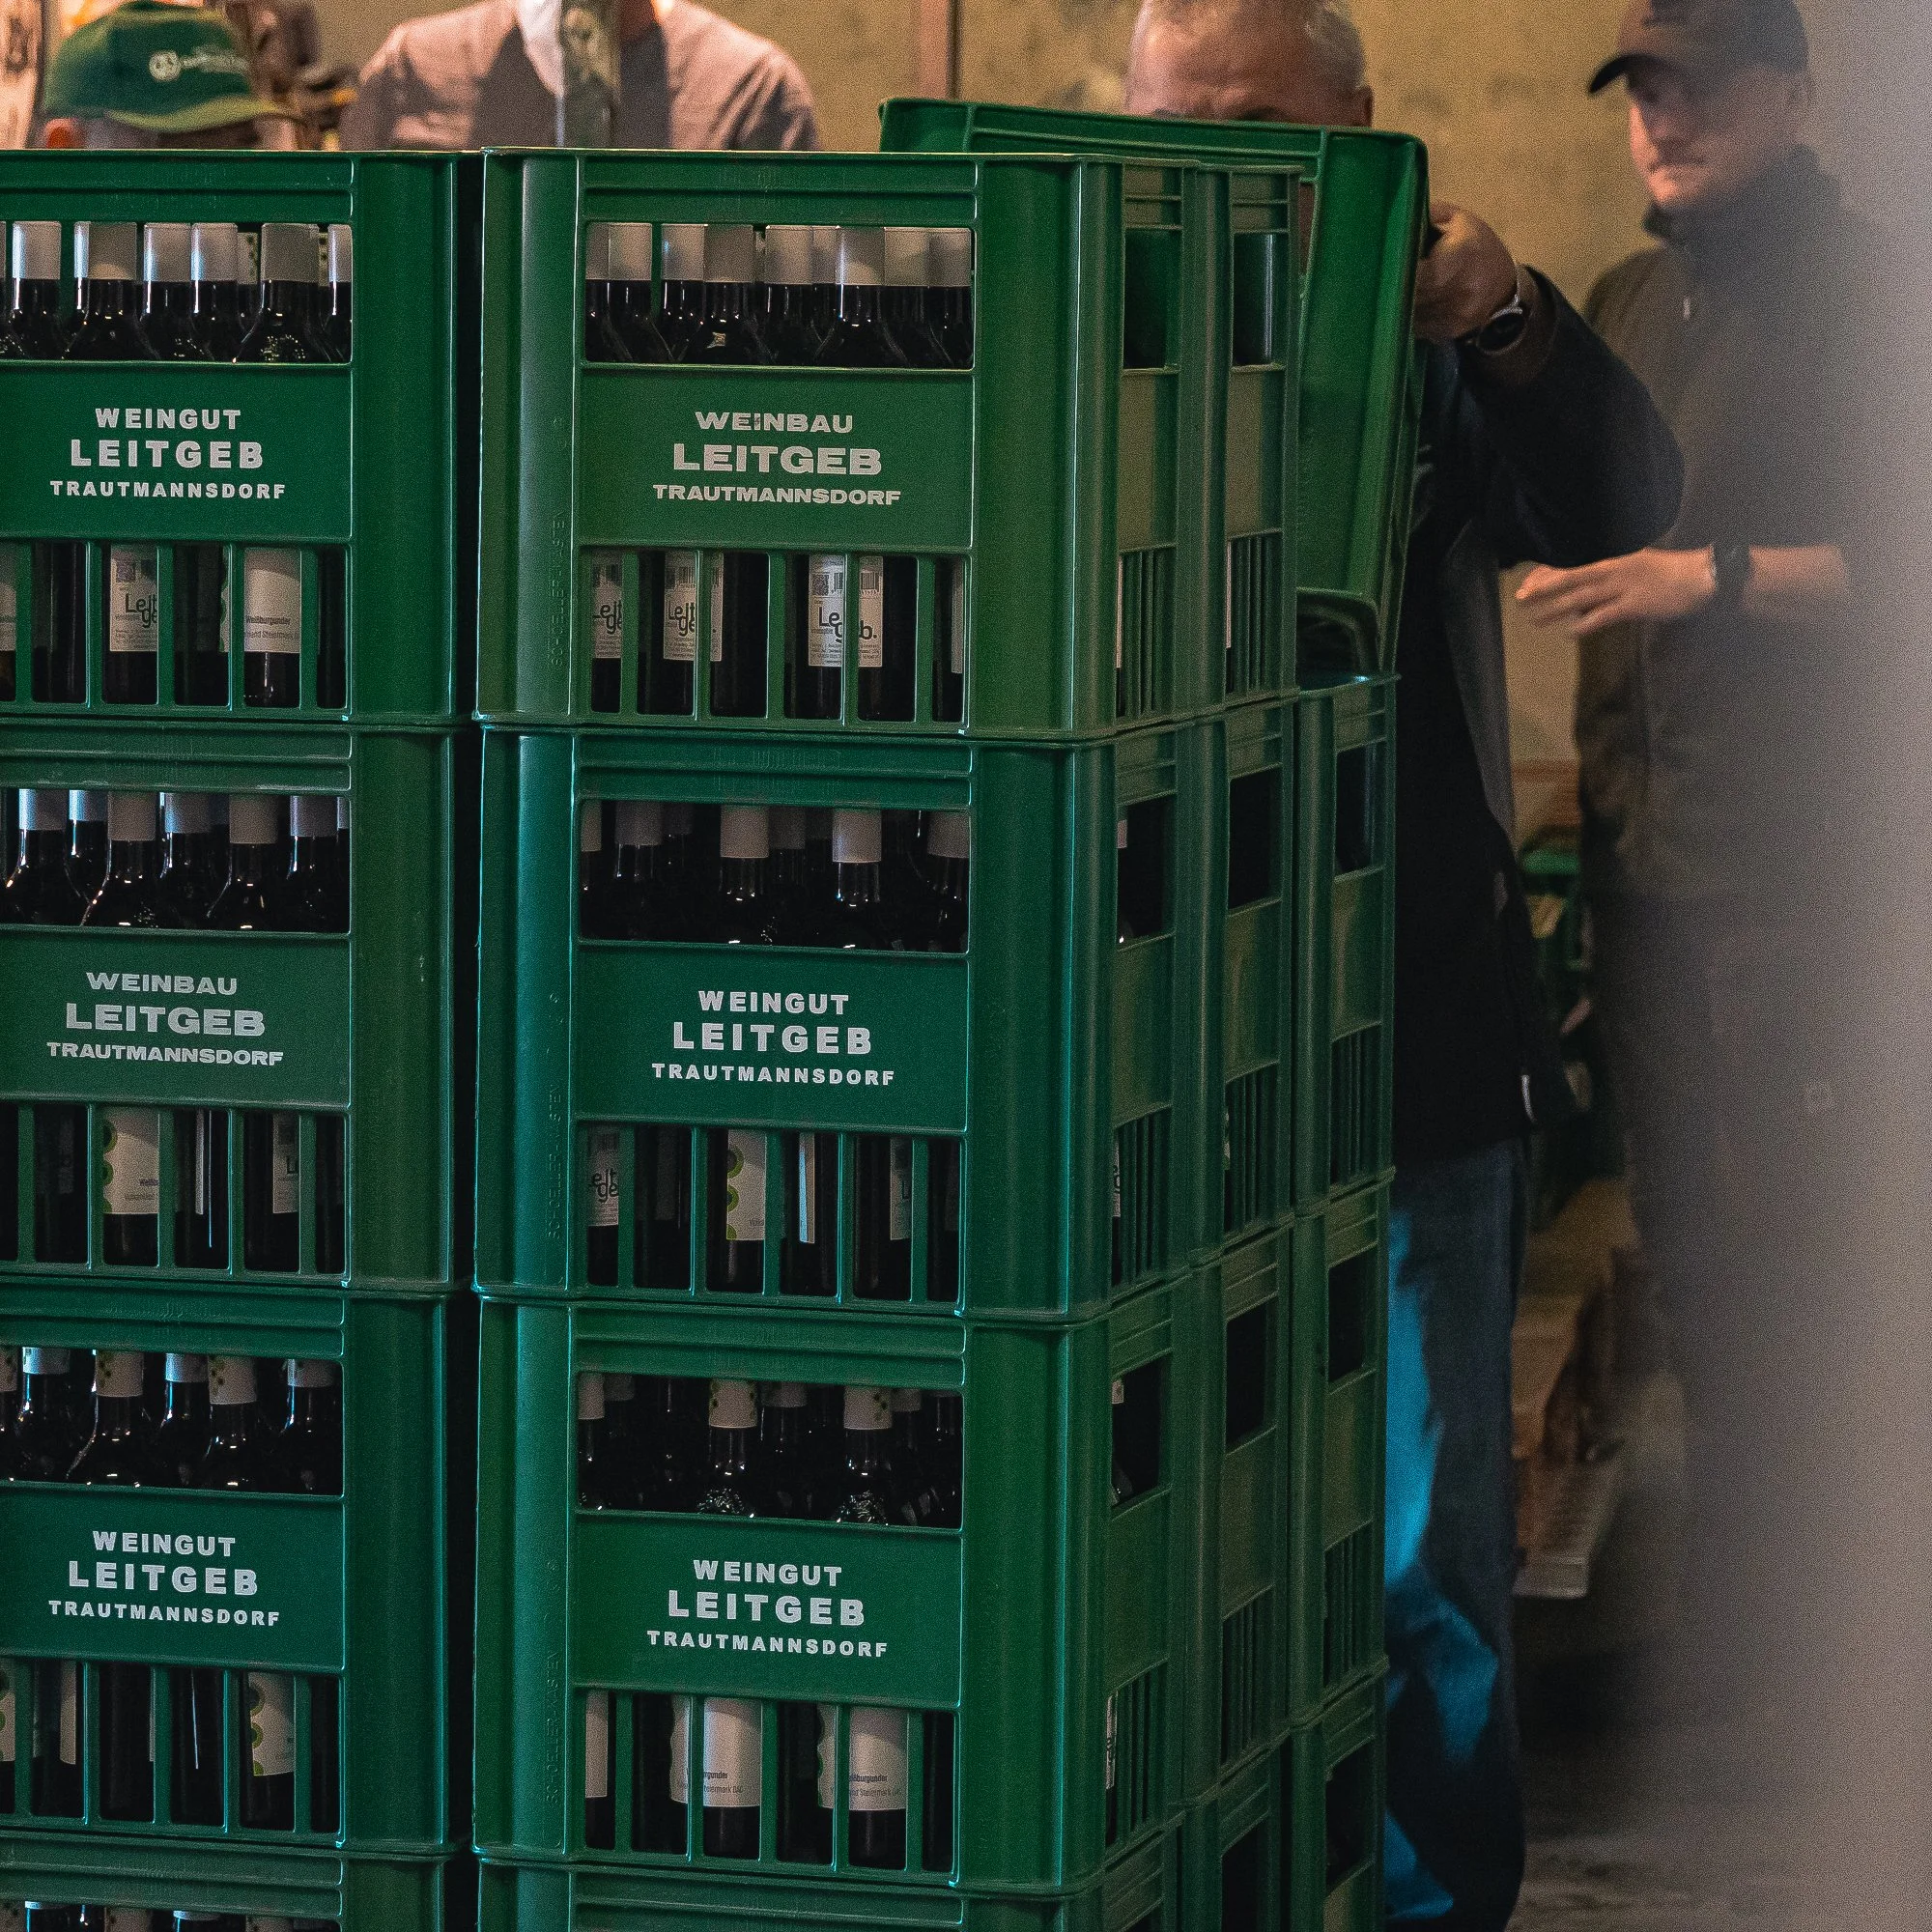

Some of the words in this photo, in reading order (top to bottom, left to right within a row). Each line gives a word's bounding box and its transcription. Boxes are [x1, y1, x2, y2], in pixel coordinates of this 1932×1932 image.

[95, 408, 242, 430] WEINGUT
[695, 411, 853, 434] WEINBAU
[71, 439, 264, 469] LEITGEB
[673, 442, 882, 476] LEITGEB
[49, 480, 287, 499] TRAUTMANNSDORF
[652, 484, 901, 506] TRAUTMANNSDORF
[86, 972, 239, 996] WEINBAU
[697, 990, 849, 1015] WEINGUT
[66, 1002, 266, 1037] LEITGEB
[673, 1021, 873, 1055] LEITGEB
[46, 1041, 284, 1066] TRAUTMANNSDORF
[651, 1063, 895, 1087] TRAUTMANNSDORF
[92, 1530, 236, 1557] WEINGUT
[69, 1560, 258, 1595] LEITGEB
[693, 1559, 842, 1587] WEINGUT
[48, 1600, 280, 1627] TRAUTMANNSDORF
[667, 1589, 866, 1627] LEITGEB
[646, 1630, 888, 1659] TRAUTMANNSDORF
